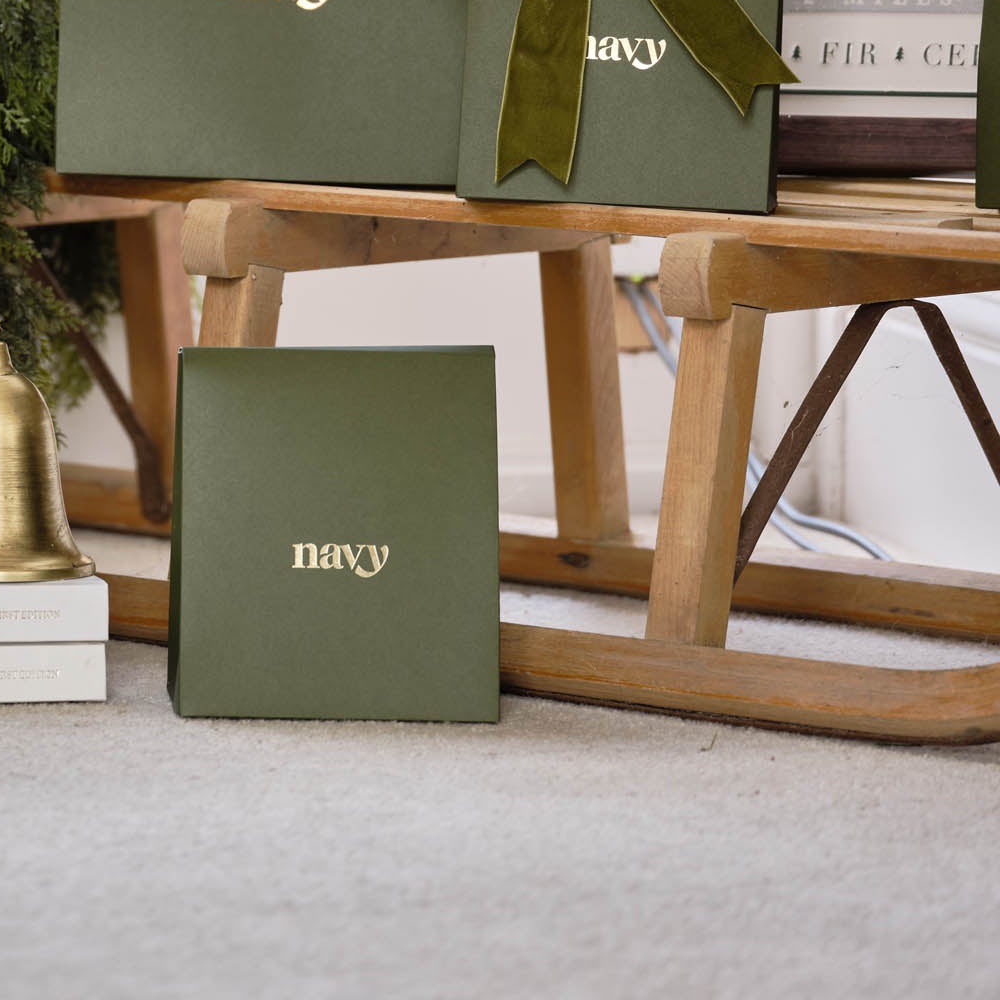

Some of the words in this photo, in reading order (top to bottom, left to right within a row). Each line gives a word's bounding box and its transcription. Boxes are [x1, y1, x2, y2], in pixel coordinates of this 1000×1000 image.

[822, 41, 876, 65] FIR
[923, 43, 978, 66] CE
[292, 542, 390, 579] navy
